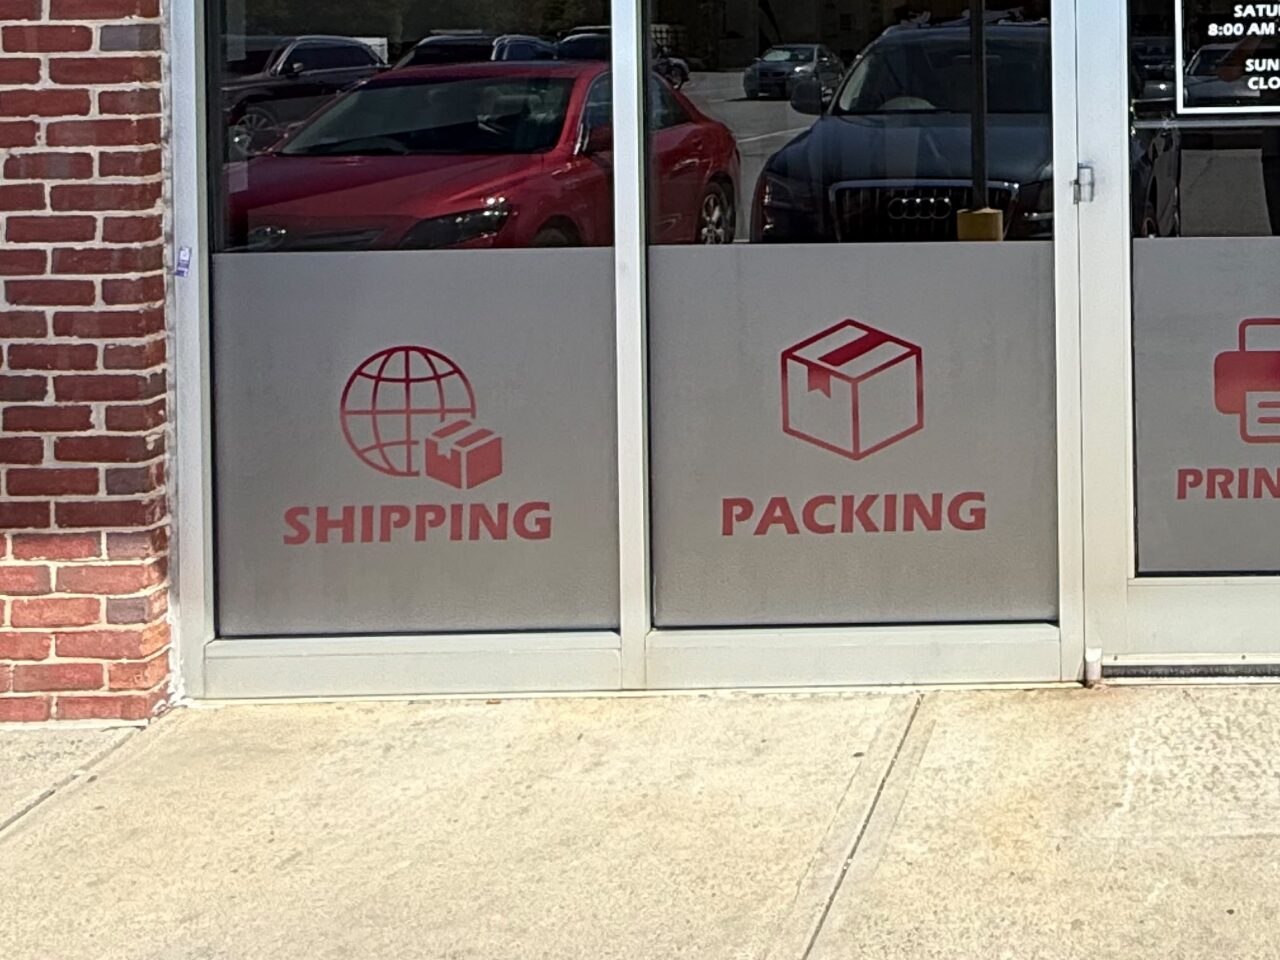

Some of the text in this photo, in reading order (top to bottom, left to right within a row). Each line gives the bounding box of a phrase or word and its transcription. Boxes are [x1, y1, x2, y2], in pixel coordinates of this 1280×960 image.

[1207, 23, 1244, 36] 8:00
[1246, 22, 1275, 35] AM
[283, 501, 552, 545] SHIPPING
[721, 491, 987, 536] PACKING
